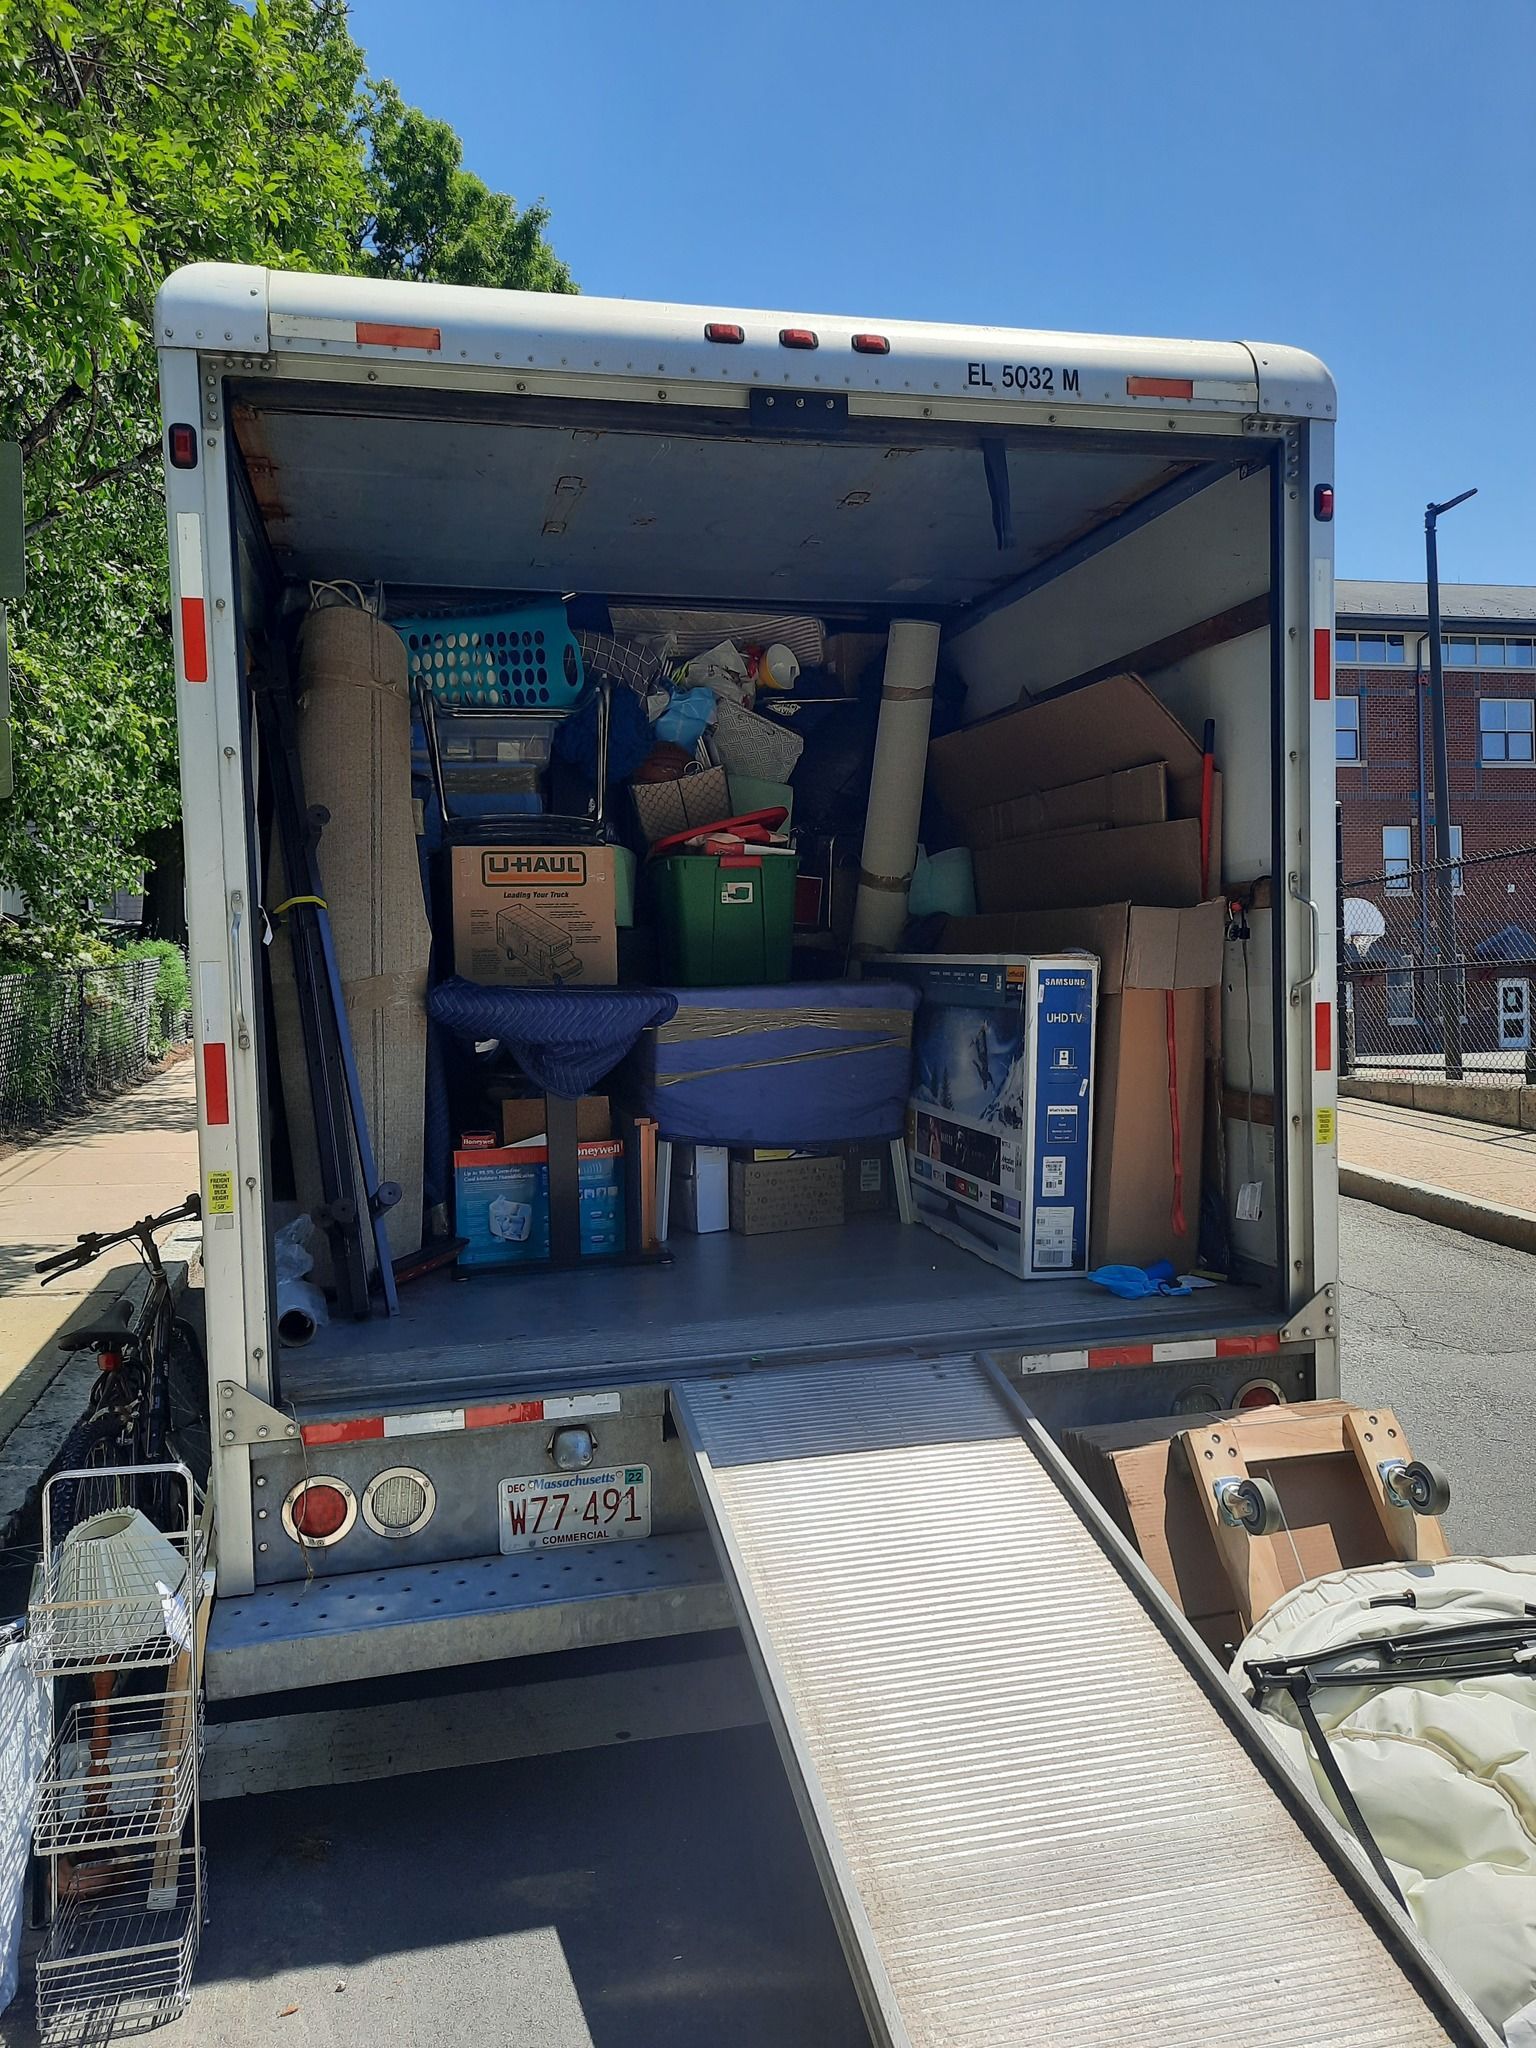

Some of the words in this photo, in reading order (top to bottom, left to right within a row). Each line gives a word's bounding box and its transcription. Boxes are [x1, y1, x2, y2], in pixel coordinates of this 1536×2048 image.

[967, 362, 993, 387] EL
[1002, 364, 1054, 390] 5032
[1062, 368, 1079, 391] M
[488, 856, 580, 873] U-HAUL
[503, 891, 531, 899] Loading
[533, 891, 549, 899] Your
[550, 890, 569, 898] Truck
[1044, 977, 1086, 986] SAMSUNG
[1046, 1013, 1068, 1024] UHD
[1070, 1014, 1083, 1024] TV
[463, 1138, 495, 1146] Honeywell
[577, 1143, 620, 1156] neywell
[507, 1483, 526, 1494] DEC
[533, 1472, 616, 1491] Massachusetts
[628, 1472, 642, 1482] 22
[542, 1530, 609, 1545] COMMERCIAL
